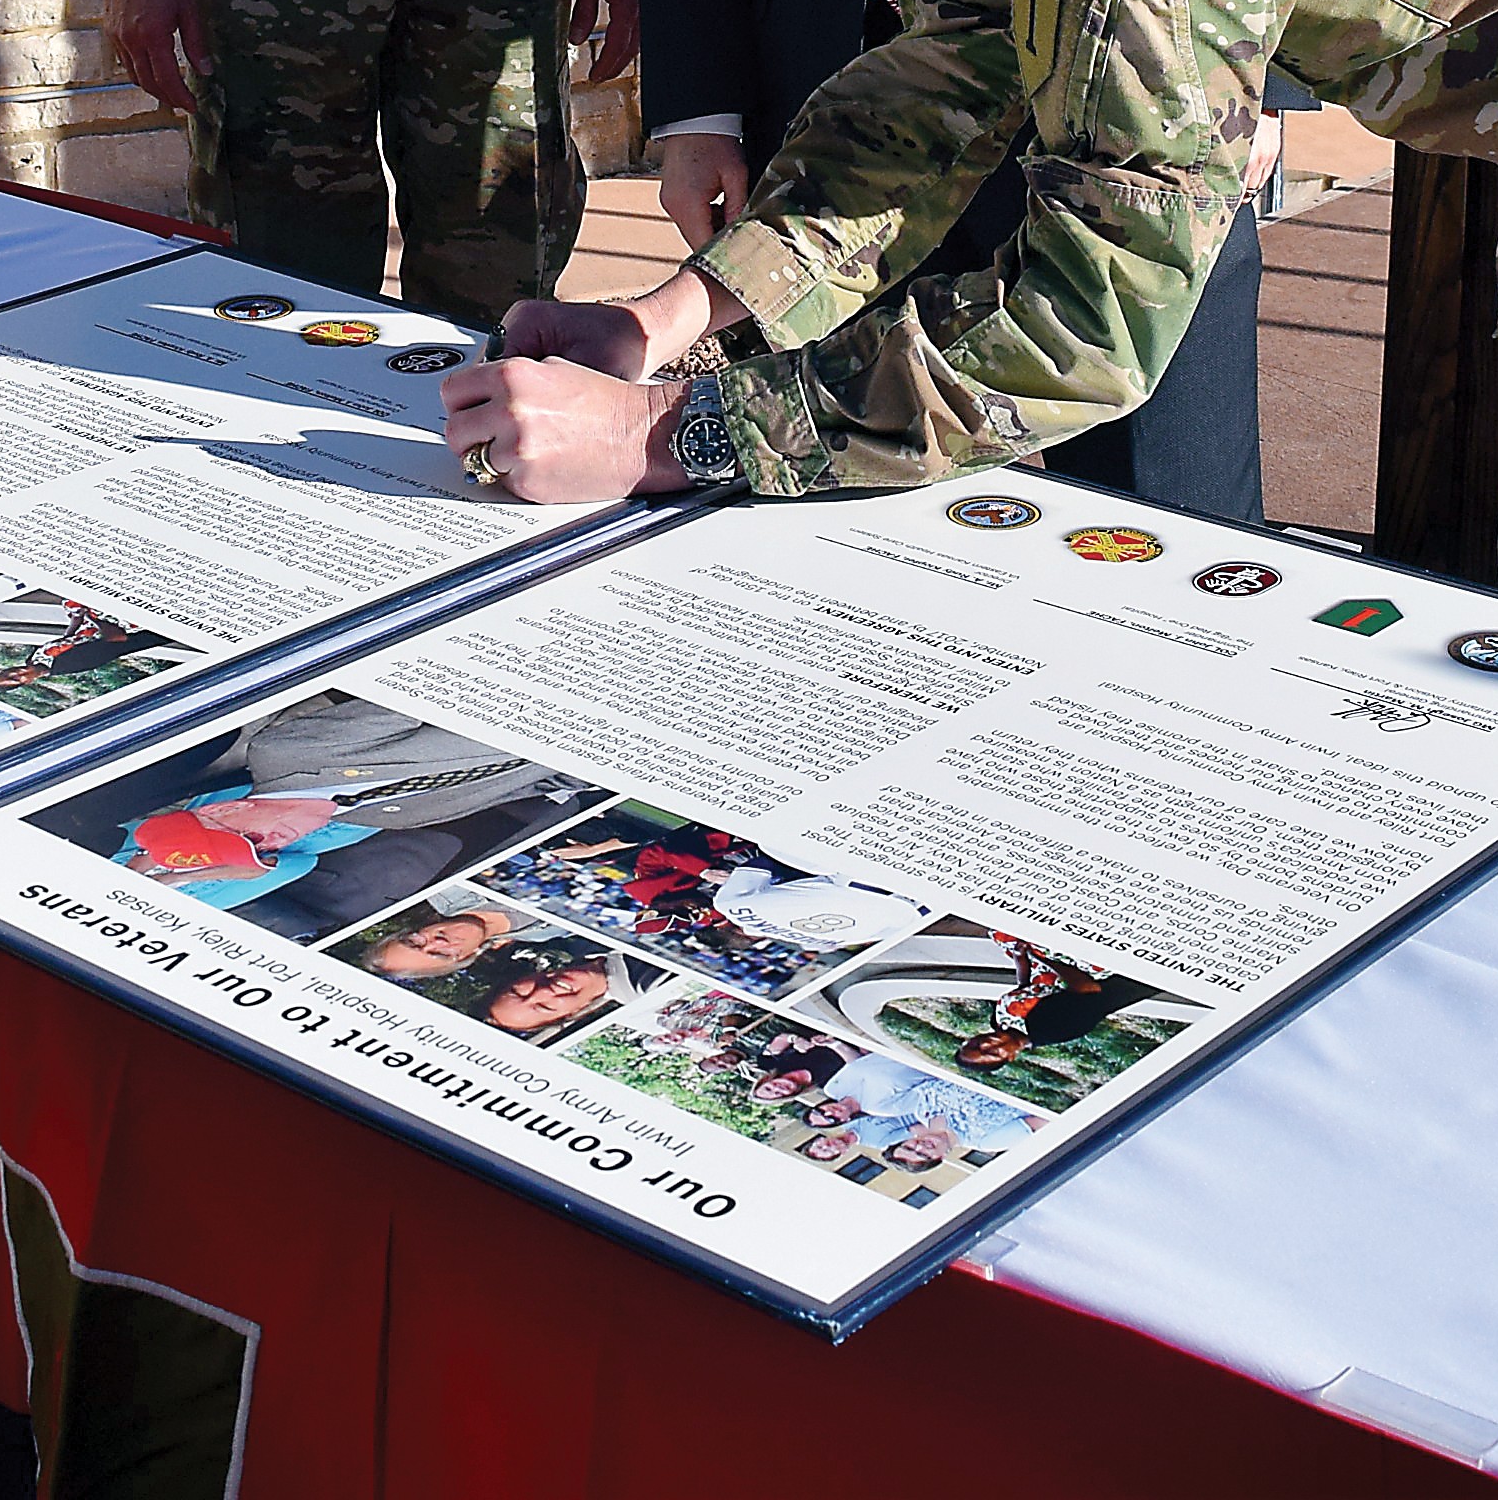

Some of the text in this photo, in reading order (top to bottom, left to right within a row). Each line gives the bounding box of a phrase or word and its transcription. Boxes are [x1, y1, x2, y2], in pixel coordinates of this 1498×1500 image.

[58, 374, 215, 429] ENTER INTO THIS AGREEMENT,
[50, 421, 137, 454] WE THEREFORE,
[35, 562, 58, 573] the
[711, 571, 733, 581] day
[64, 574, 125, 598] MILITARY
[732, 579, 766, 593] 15th
[766, 590, 791, 601] the
[120, 595, 170, 615] STATES
[618, 600, 681, 624] Resource
[791, 597, 811, 606] on
[166, 612, 217, 634] UNITED
[709, 562, 1047, 669] November, 2017 by and between the undersigned.
[811, 603, 908, 636] AGREEMENT,
[212, 629, 243, 644] THE
[680, 620, 756, 647] Healthcare
[905, 633, 942, 648] THIS
[767, 648, 797, 660] into
[942, 644, 982, 659] INTO
[796, 657, 836, 672] enter
[980, 655, 1035, 676] ENTER
[836, 669, 932, 705] THEREFORE,
[930, 700, 960, 714] WE
[829, 802, 1287, 965] Marine Corps, and Coast Guard demonstrate a resolute
[822, 824, 1261, 981] capable fighting force the world has ever known. The
[851, 819, 1273, 974] brave men and women of our Army, Navy, Air Force,
[800, 829, 1245, 993] THE UNITED STATES MILITARY is the strongest, most
[789, 913, 856, 934] 8
[105, 889, 695, 1158] Irwin Army Community Hospital, Fort Riley, Kansas
[17, 882, 738, 1219] Our Commitment to Our Veterans
